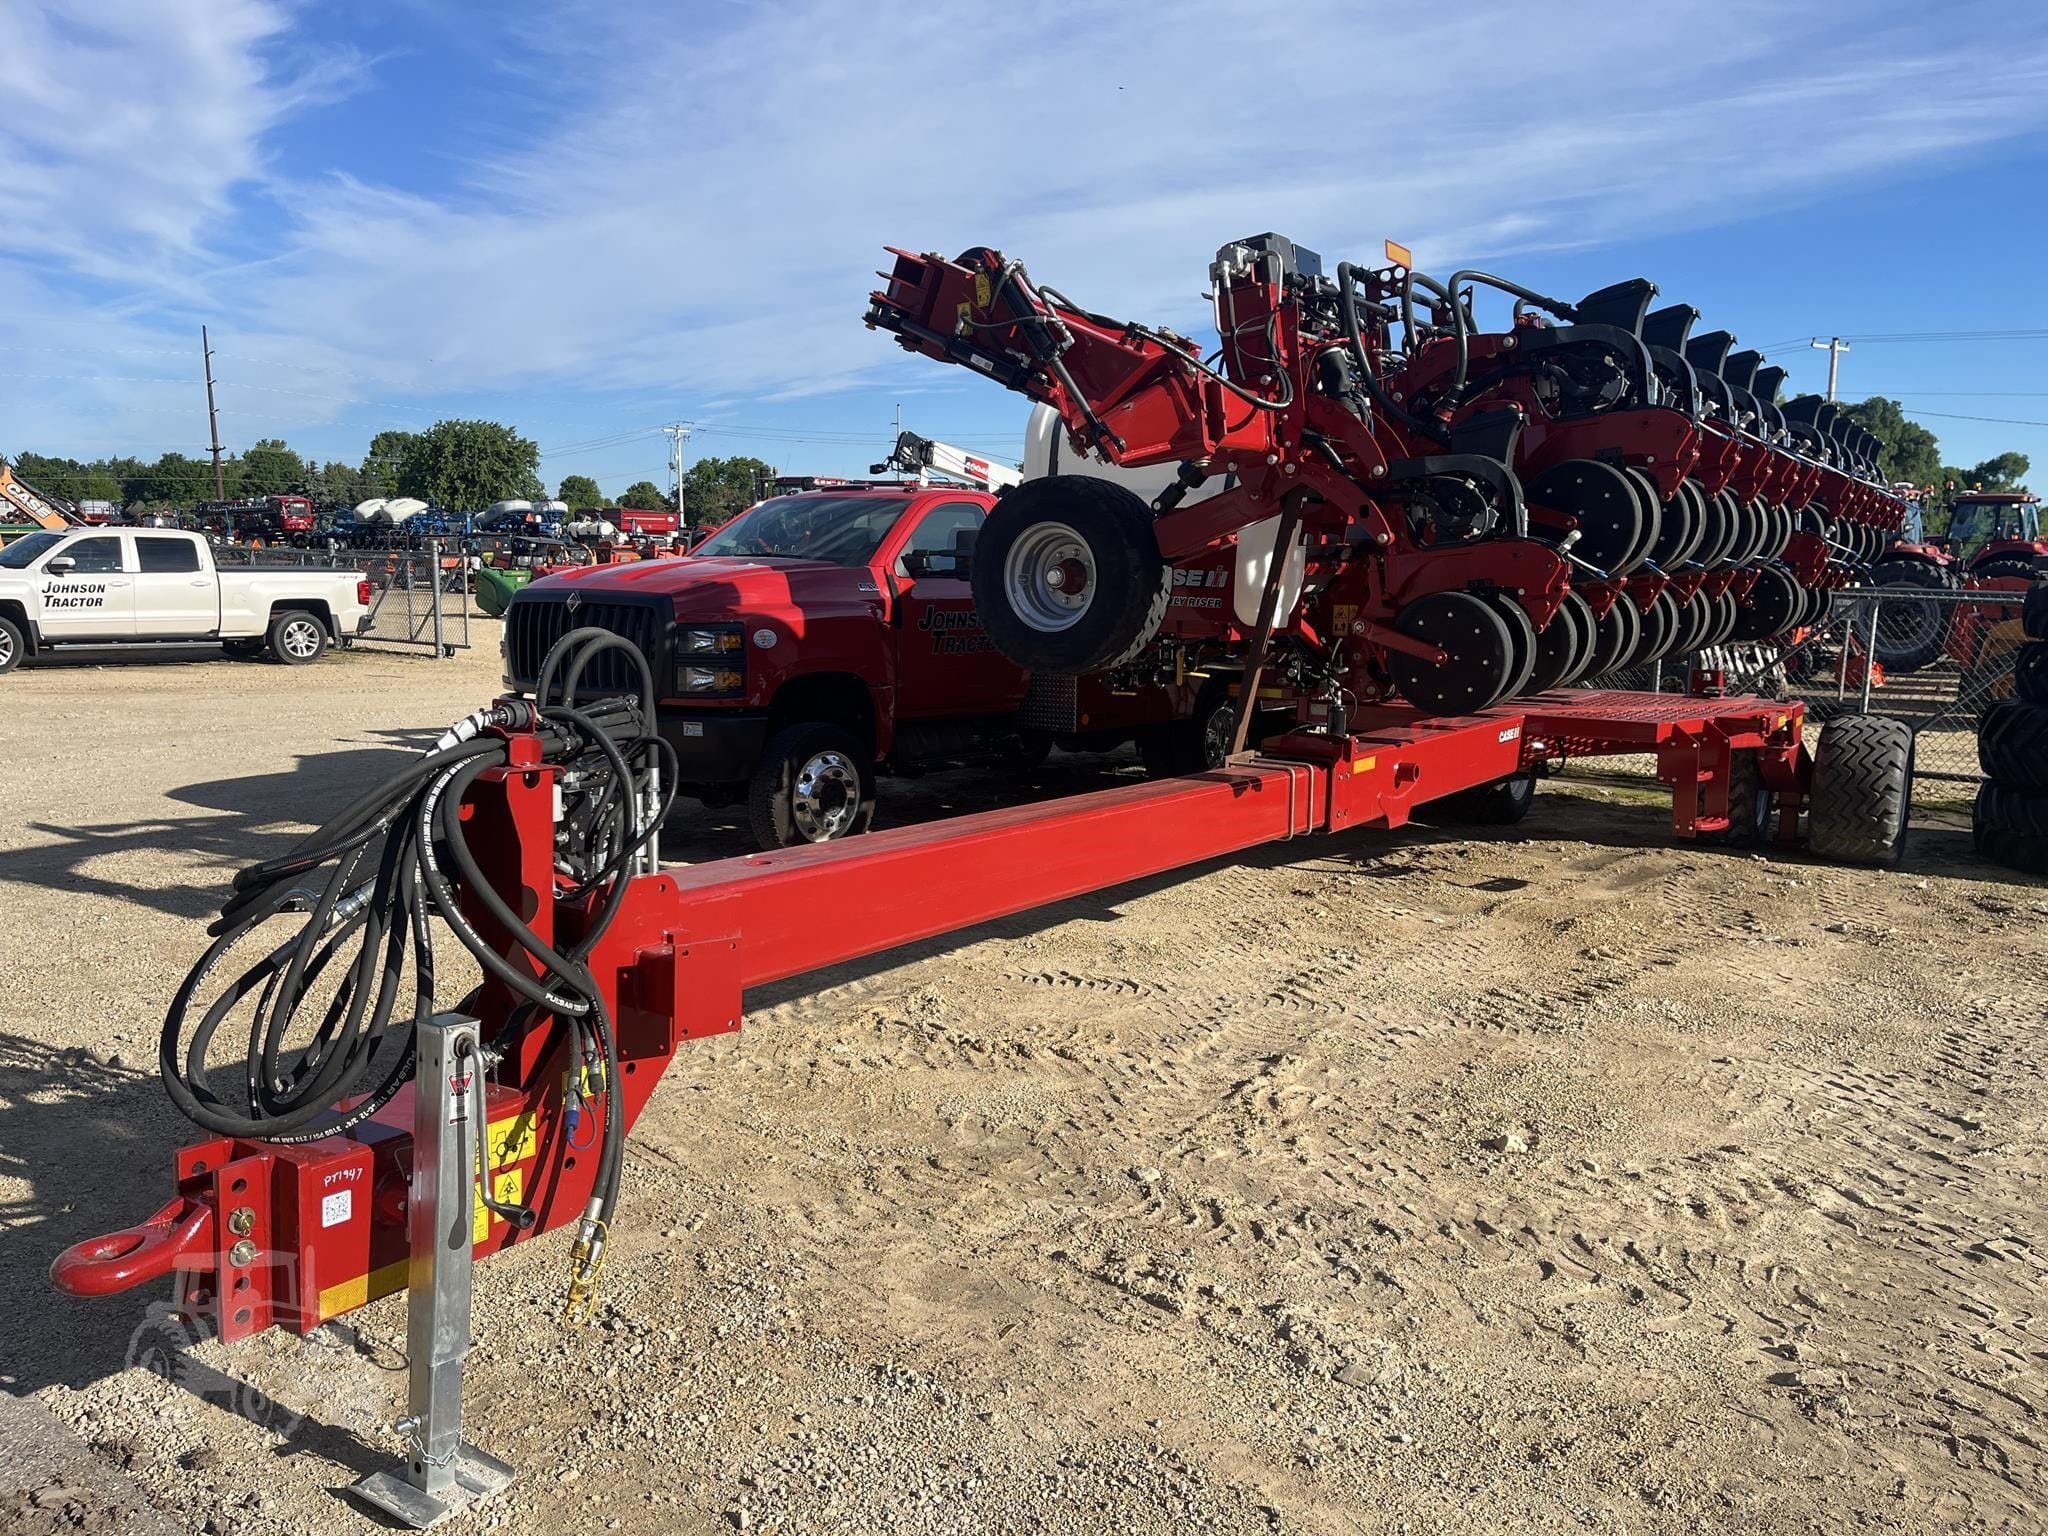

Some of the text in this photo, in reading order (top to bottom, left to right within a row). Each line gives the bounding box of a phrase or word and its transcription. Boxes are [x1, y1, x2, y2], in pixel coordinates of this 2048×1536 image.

[6, 483, 51, 518] CASE
[41, 581, 106, 594] JOHNSON
[1172, 568, 1205, 588] SE
[44, 595, 104, 607] TRACTOR
[1187, 597, 1223, 609] RISER
[917, 604, 984, 632] JOHNS
[931, 630, 997, 655] TRACT
[324, 1167, 363, 1187] PT1947
